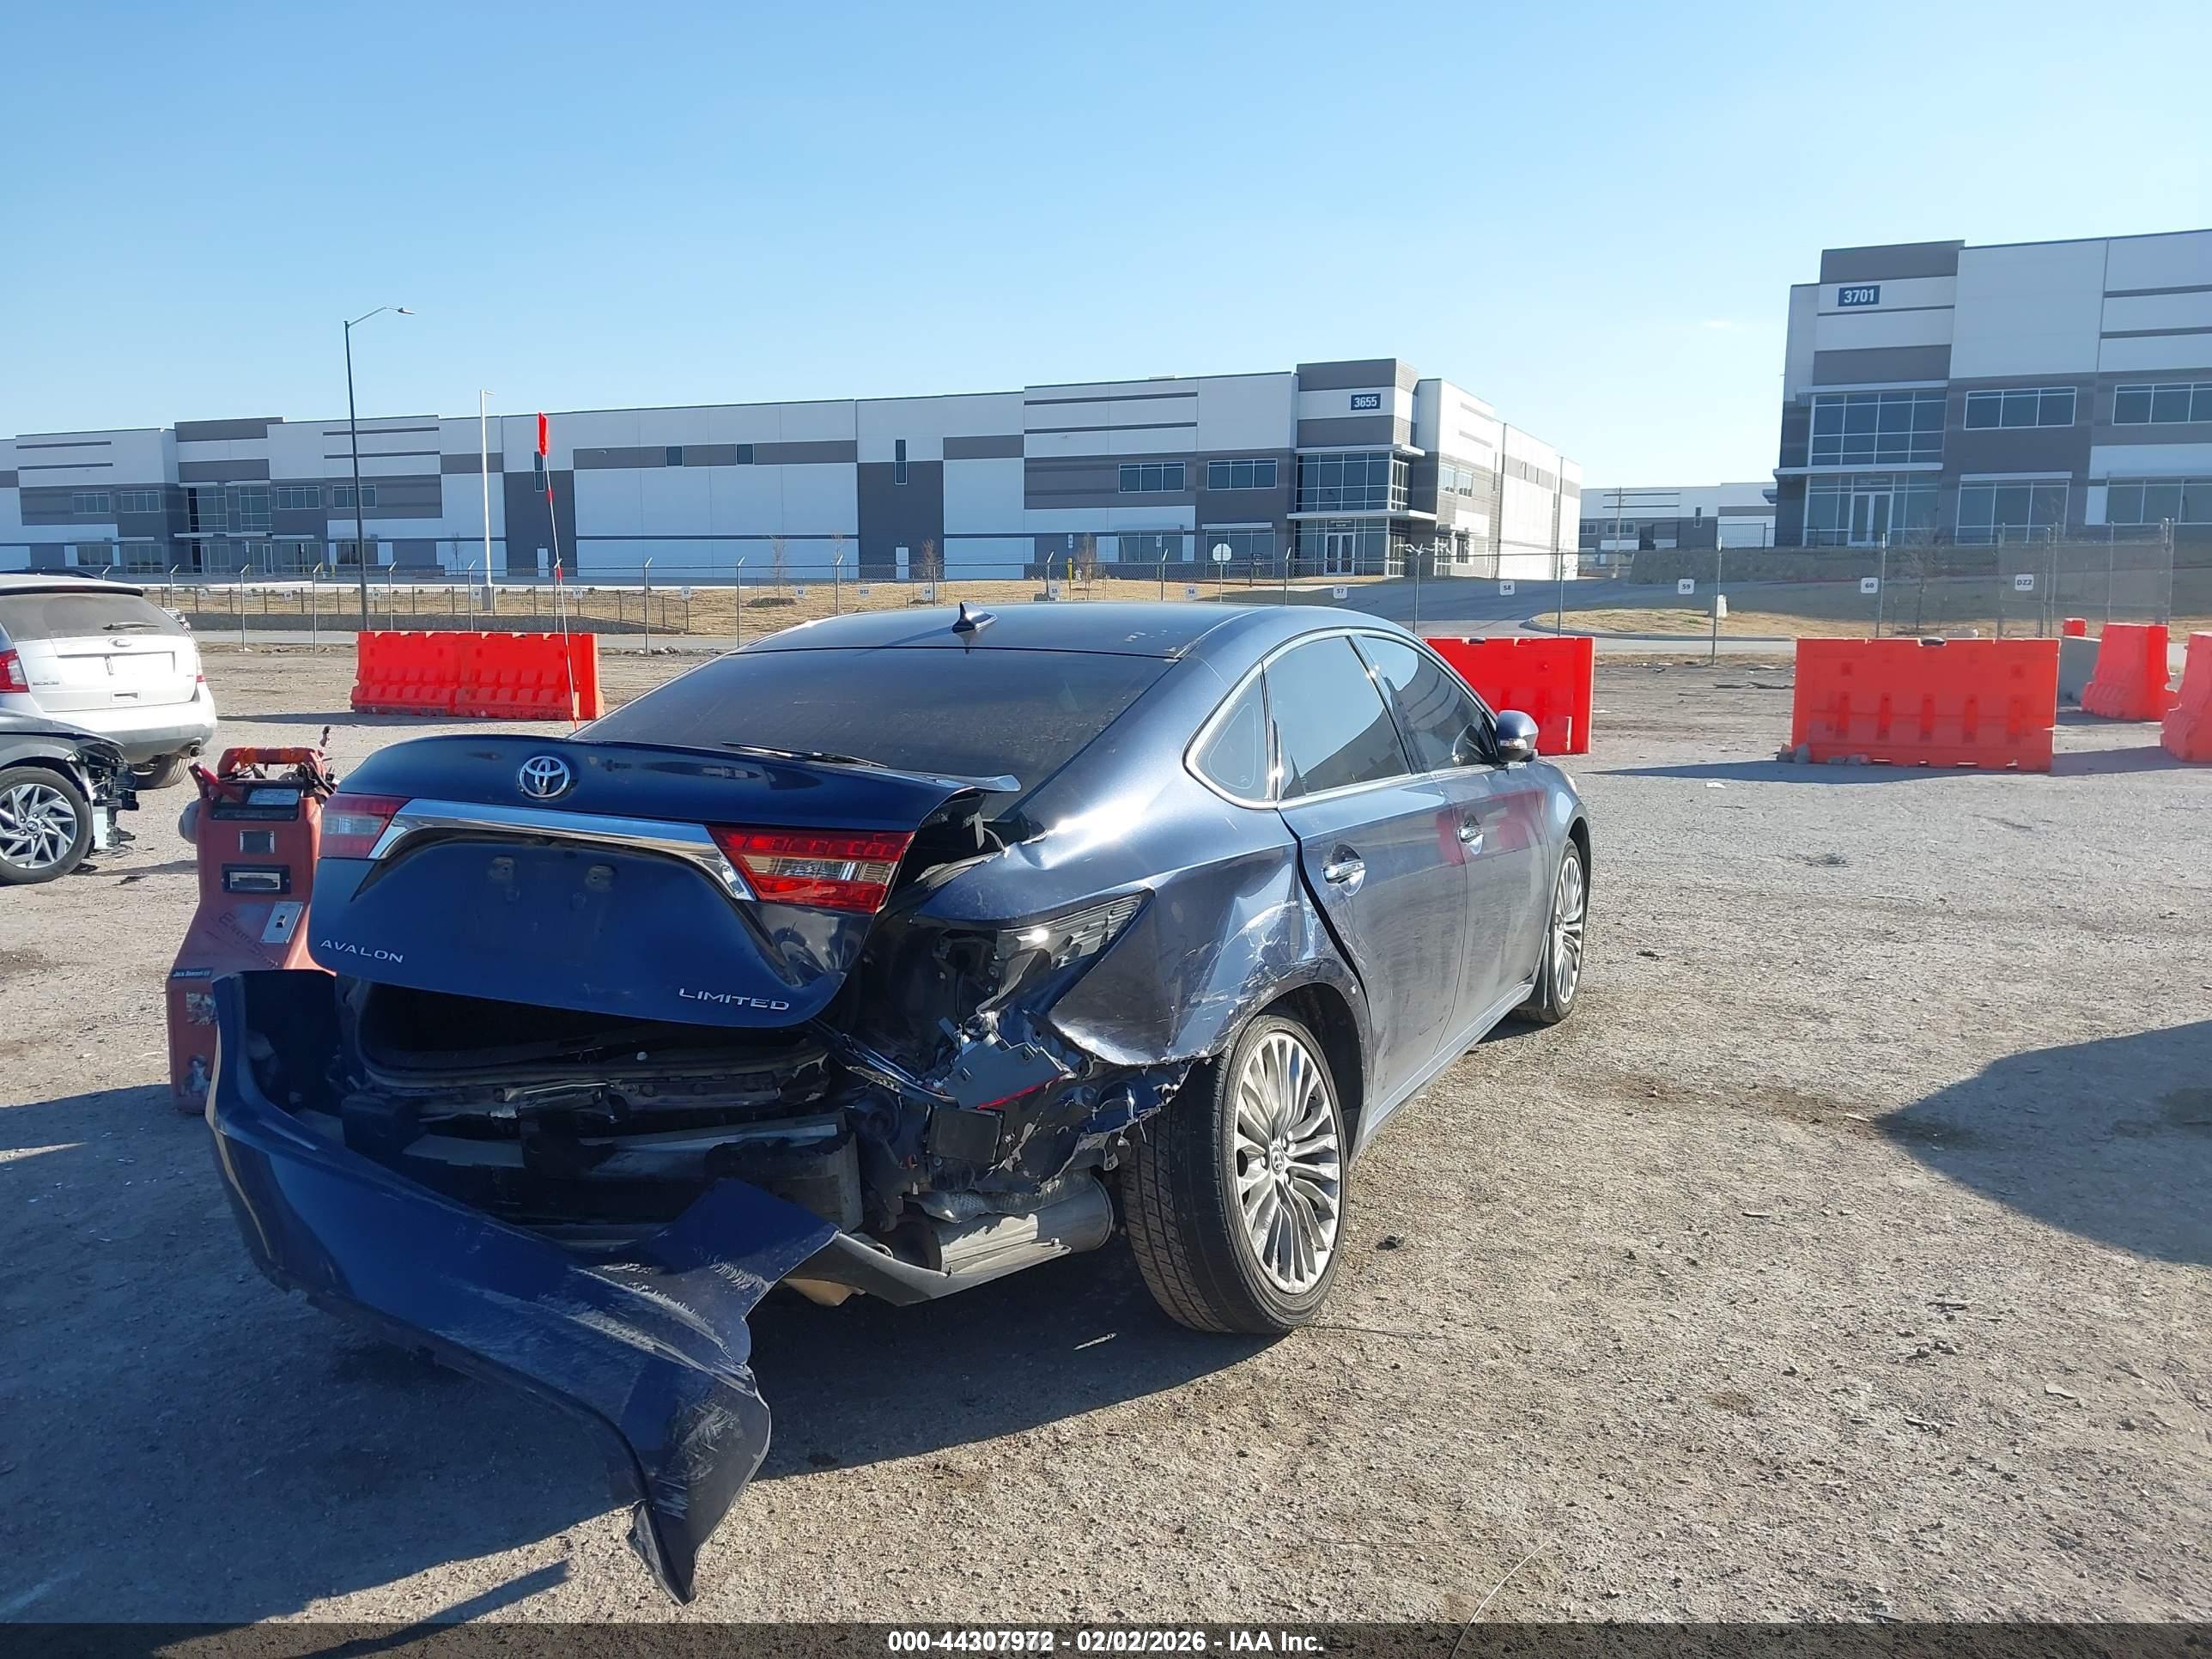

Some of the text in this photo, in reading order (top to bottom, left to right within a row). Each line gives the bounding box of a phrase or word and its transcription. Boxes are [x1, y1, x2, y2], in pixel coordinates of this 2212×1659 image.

[1844, 289, 1875, 303] 3701
[1353, 396, 1377, 408] 3655
[320, 939, 404, 963] AVALON
[678, 988, 790, 1011] LIMITED
